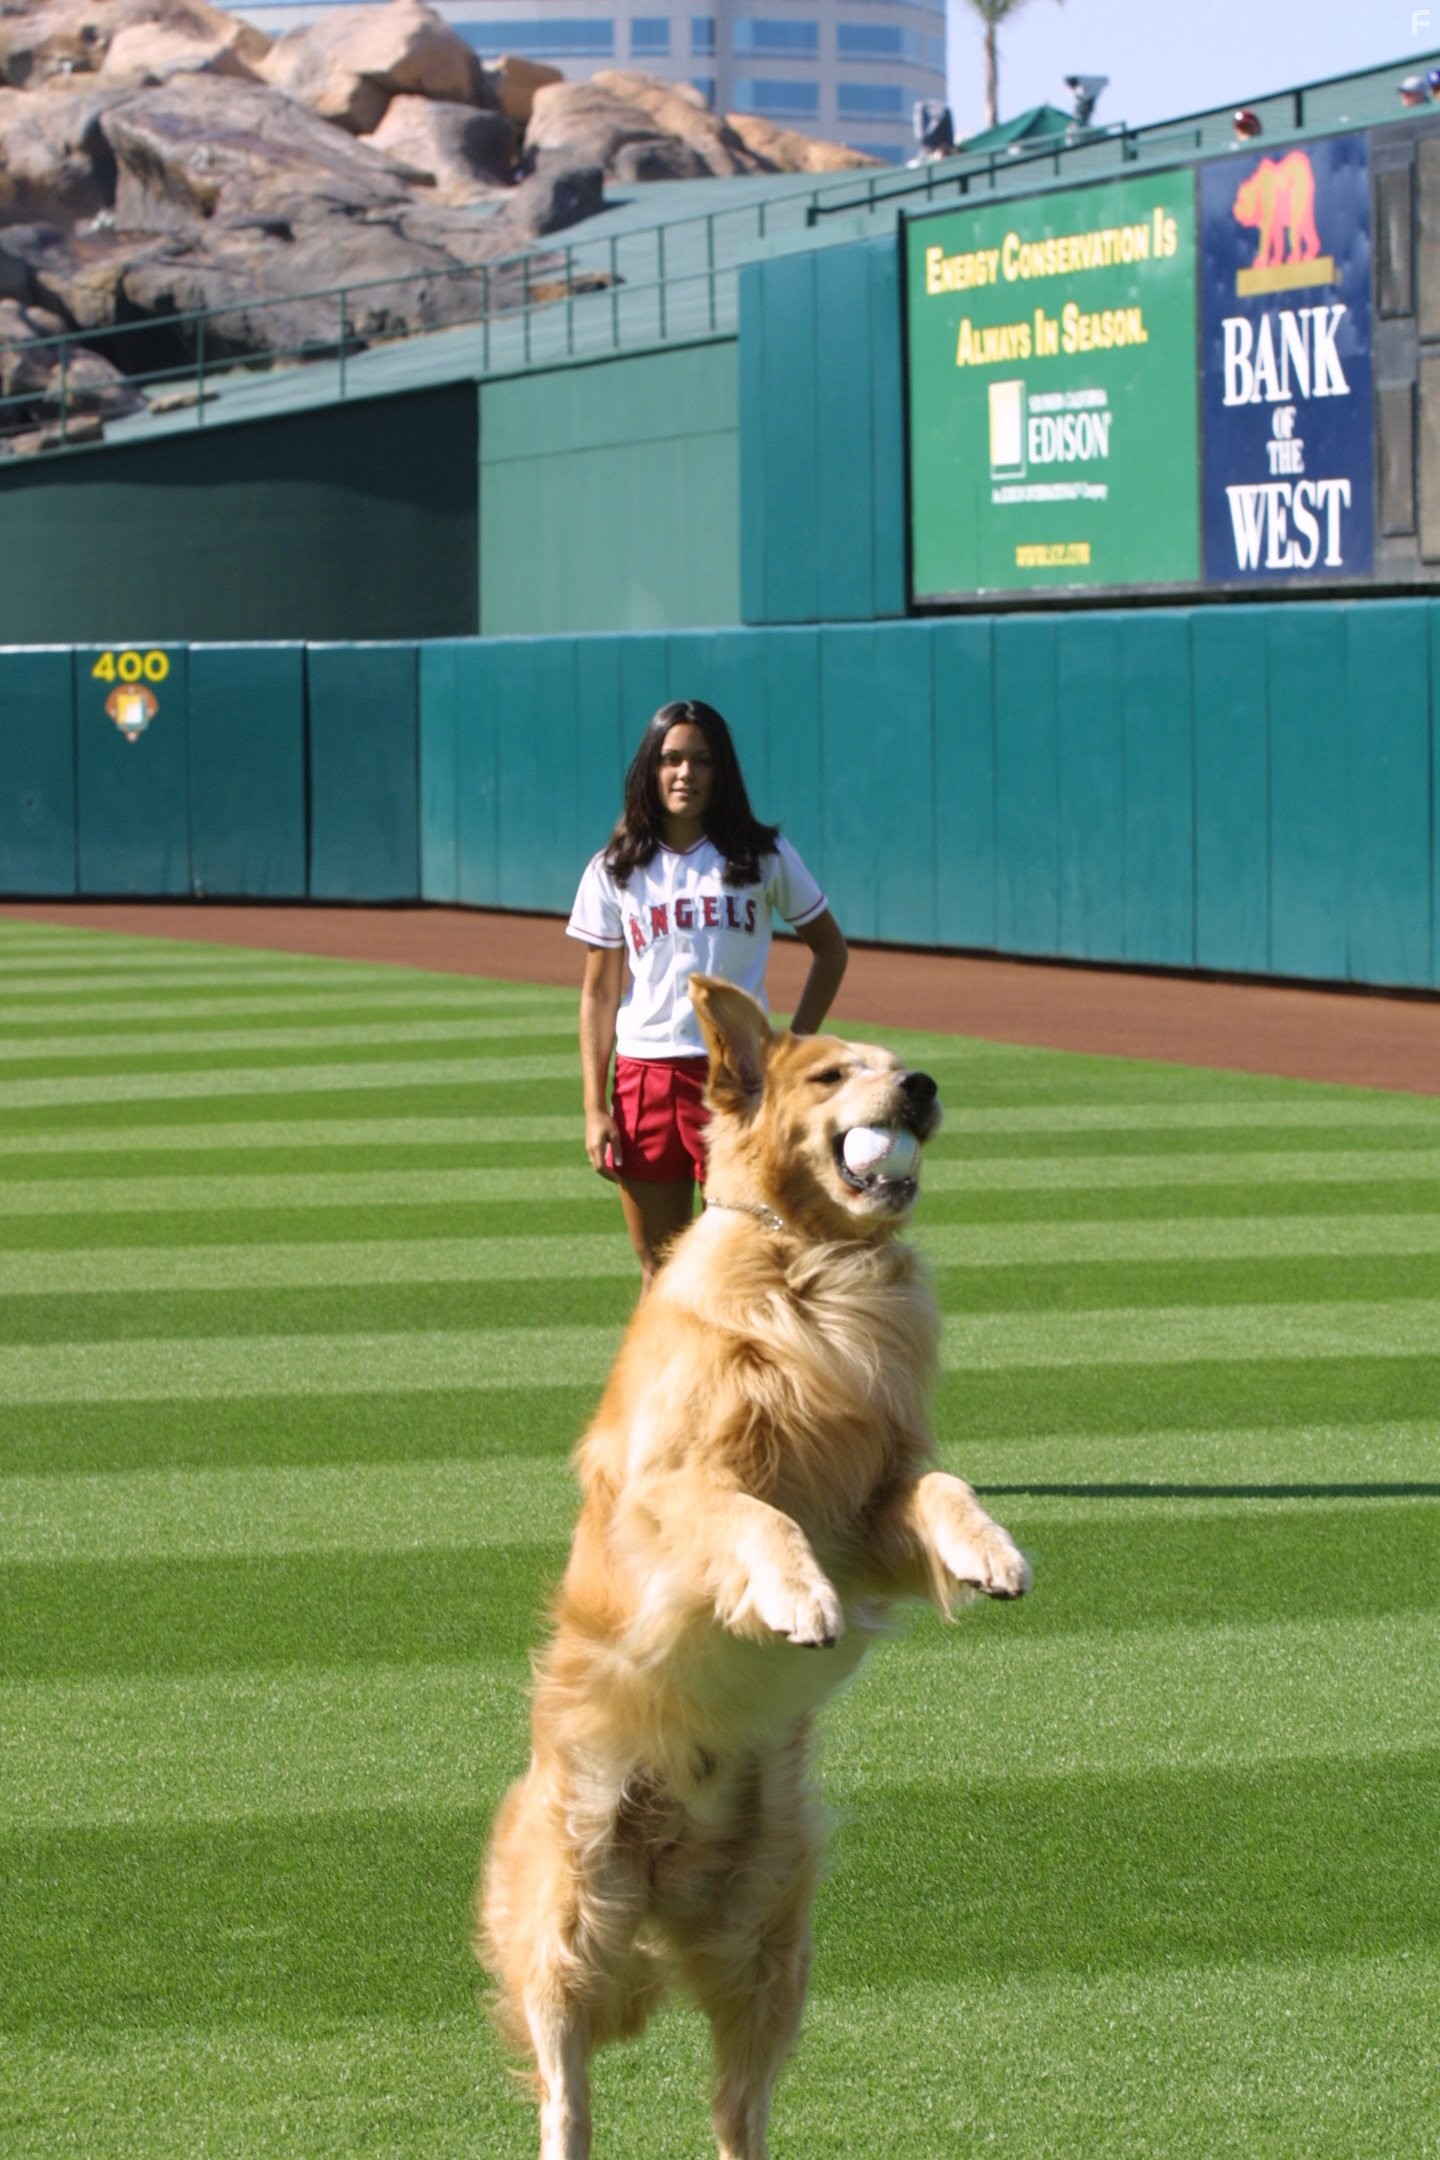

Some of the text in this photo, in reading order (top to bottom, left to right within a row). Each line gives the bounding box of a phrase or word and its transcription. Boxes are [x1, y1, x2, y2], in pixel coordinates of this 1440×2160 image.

[1002, 223, 1150, 282] CONSERVATION
[1222, 304, 1350, 406] BANK
[1028, 411, 1110, 464] EDISON
[1271, 405, 1297, 440] OF
[1266, 439, 1305, 475] THE
[1225, 479, 1351, 571] WEST
[91, 650, 170, 682] 400
[628, 895, 757, 959] ANGELS
